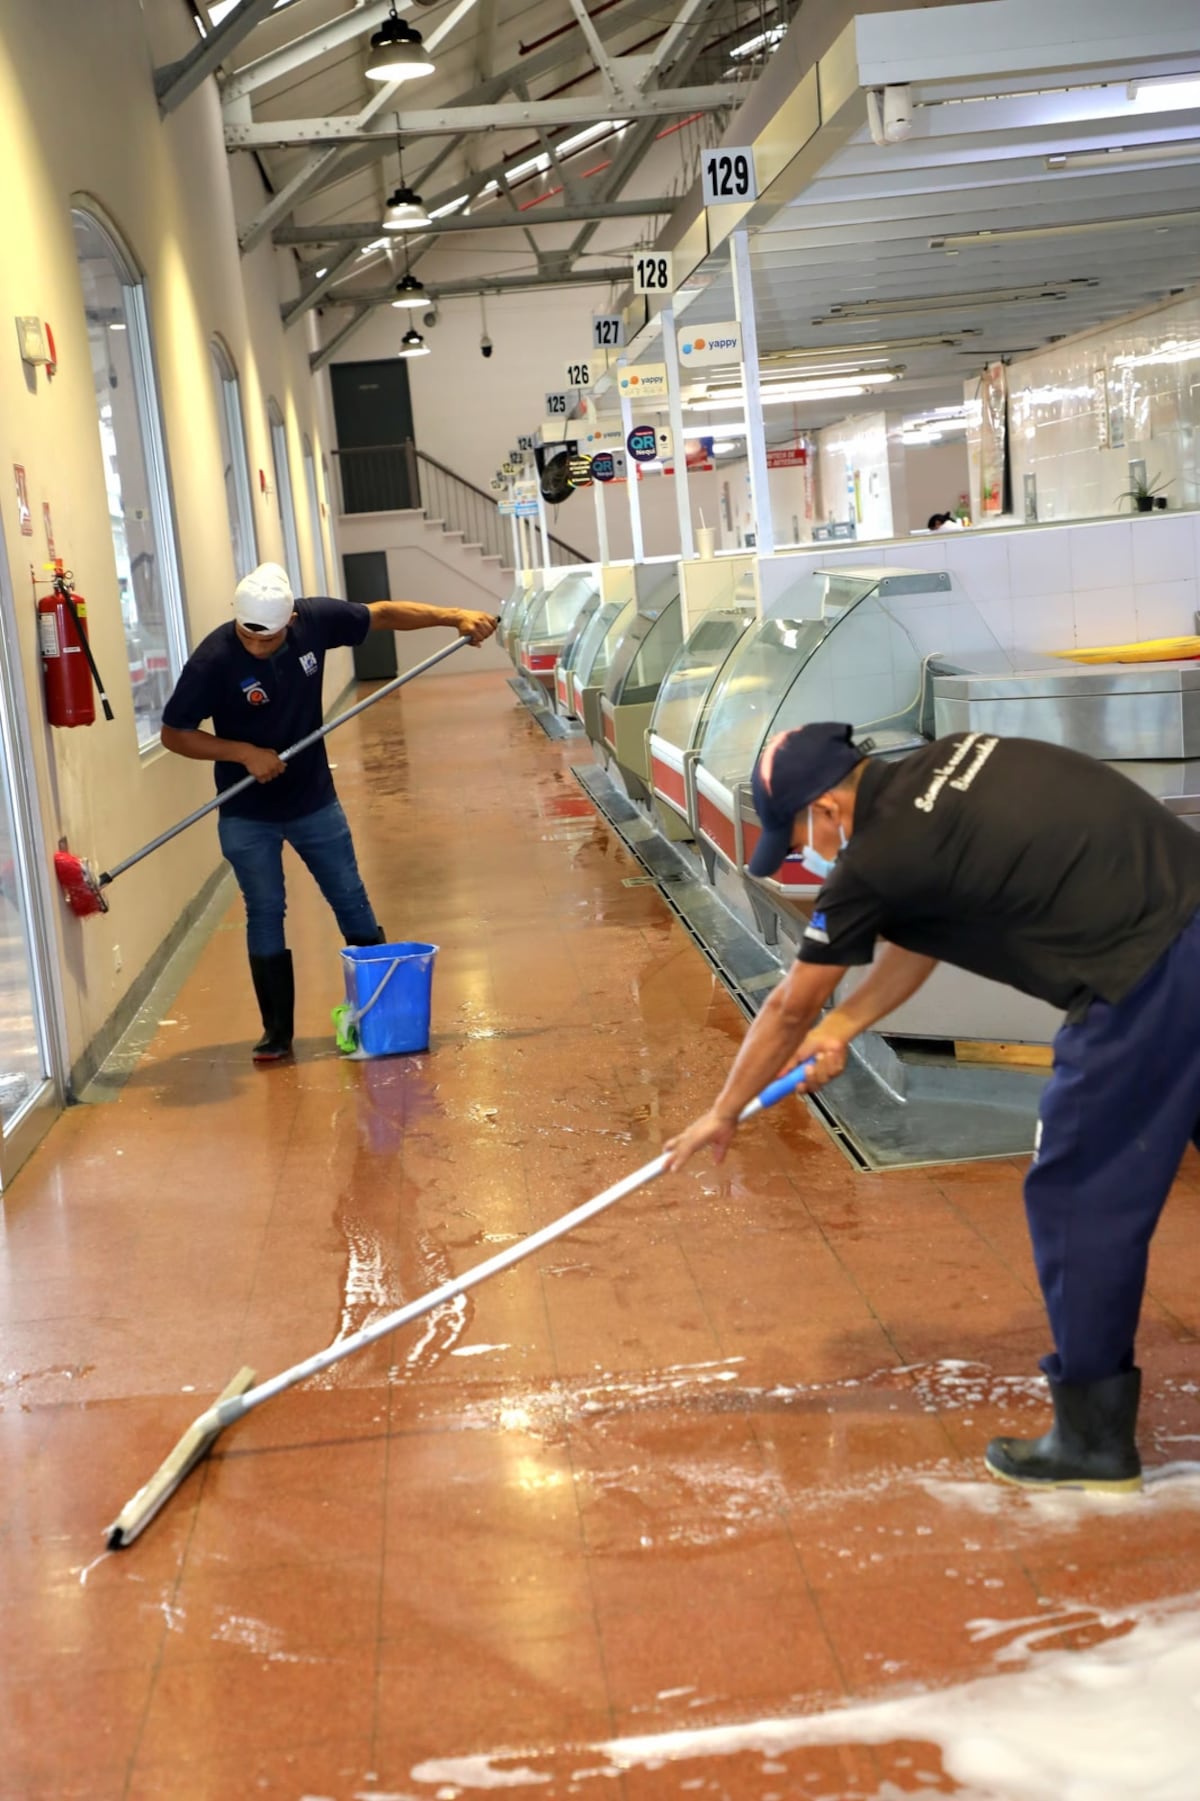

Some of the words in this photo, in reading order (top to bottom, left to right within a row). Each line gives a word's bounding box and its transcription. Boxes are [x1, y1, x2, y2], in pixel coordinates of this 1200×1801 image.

[707, 154, 749, 197] 129
[637, 258, 668, 288] 128
[595, 320, 619, 344] 127
[708, 337, 737, 349] yappy
[568, 364, 589, 385] 126
[640, 375, 664, 385] yappy
[547, 395, 566, 413] 125
[518, 437, 533, 450] 124
[630, 435, 655, 450] QR
[592, 461, 613, 473] QR
